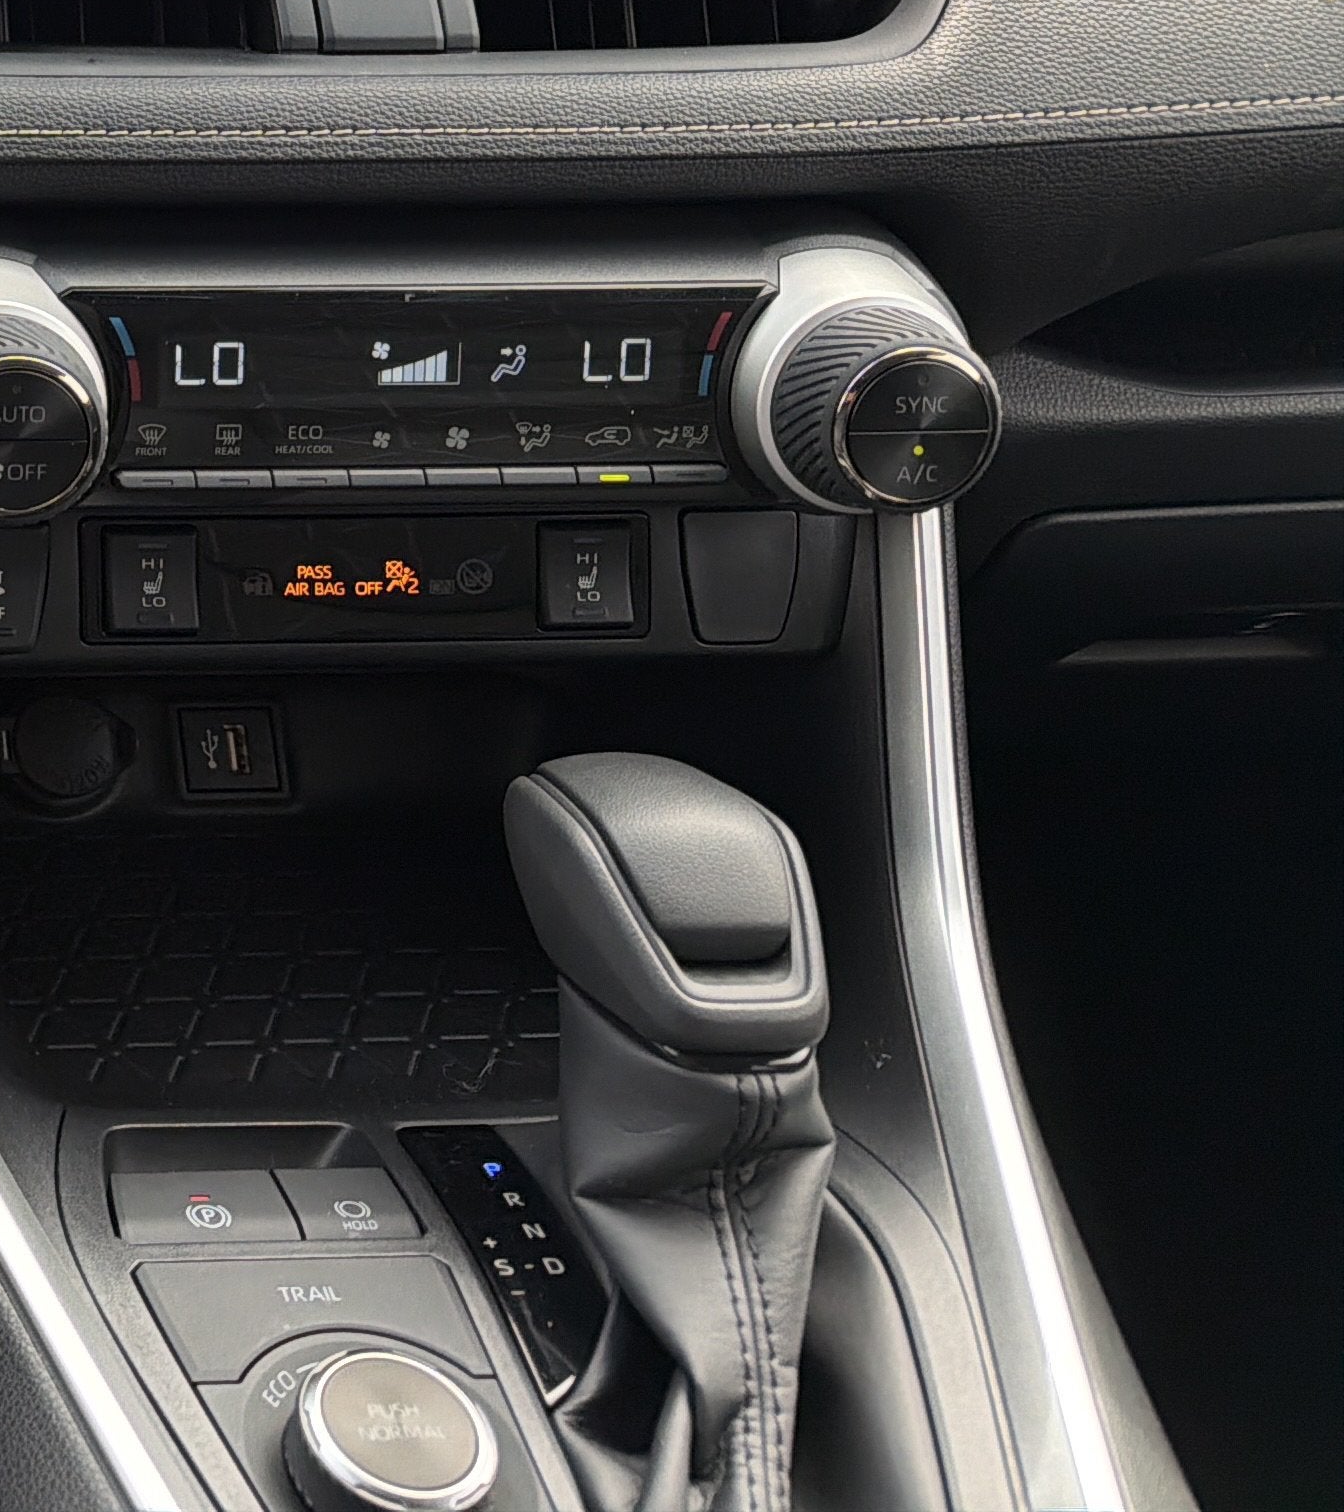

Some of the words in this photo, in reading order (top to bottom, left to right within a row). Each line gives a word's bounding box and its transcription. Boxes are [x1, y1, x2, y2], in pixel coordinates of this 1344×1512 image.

[174, 340, 245, 386] LO
[582, 337, 652, 382] LO
[894, 395, 950, 416] SYNC
[287, 425, 323, 442] ECO
[134, 444, 168, 457] FRONT
[214, 444, 242, 457] REAR
[274, 444, 335, 455] HEAT/COOL
[7, 463, 48, 481] OFF
[896, 464, 939, 484] A/C
[141, 557, 164, 569] HI
[576, 553, 599, 564] HI
[296, 564, 333, 580] PASS
[283, 582, 310, 597] AIR
[314, 582, 347, 597] BAG
[354, 581, 384, 597] OFF
[576, 591, 600, 602] LO
[141, 596, 166, 608] LO
[483, 1162, 501, 1177] P
[502, 1191, 525, 1207] R
[342, 1220, 378, 1232] HOLD
[521, 1223, 546, 1240] N
[493, 1258, 515, 1276] S
[542, 1257, 565, 1275] D
[277, 1285, 342, 1303] TRAIL
[261, 1370, 298, 1410] ECO
